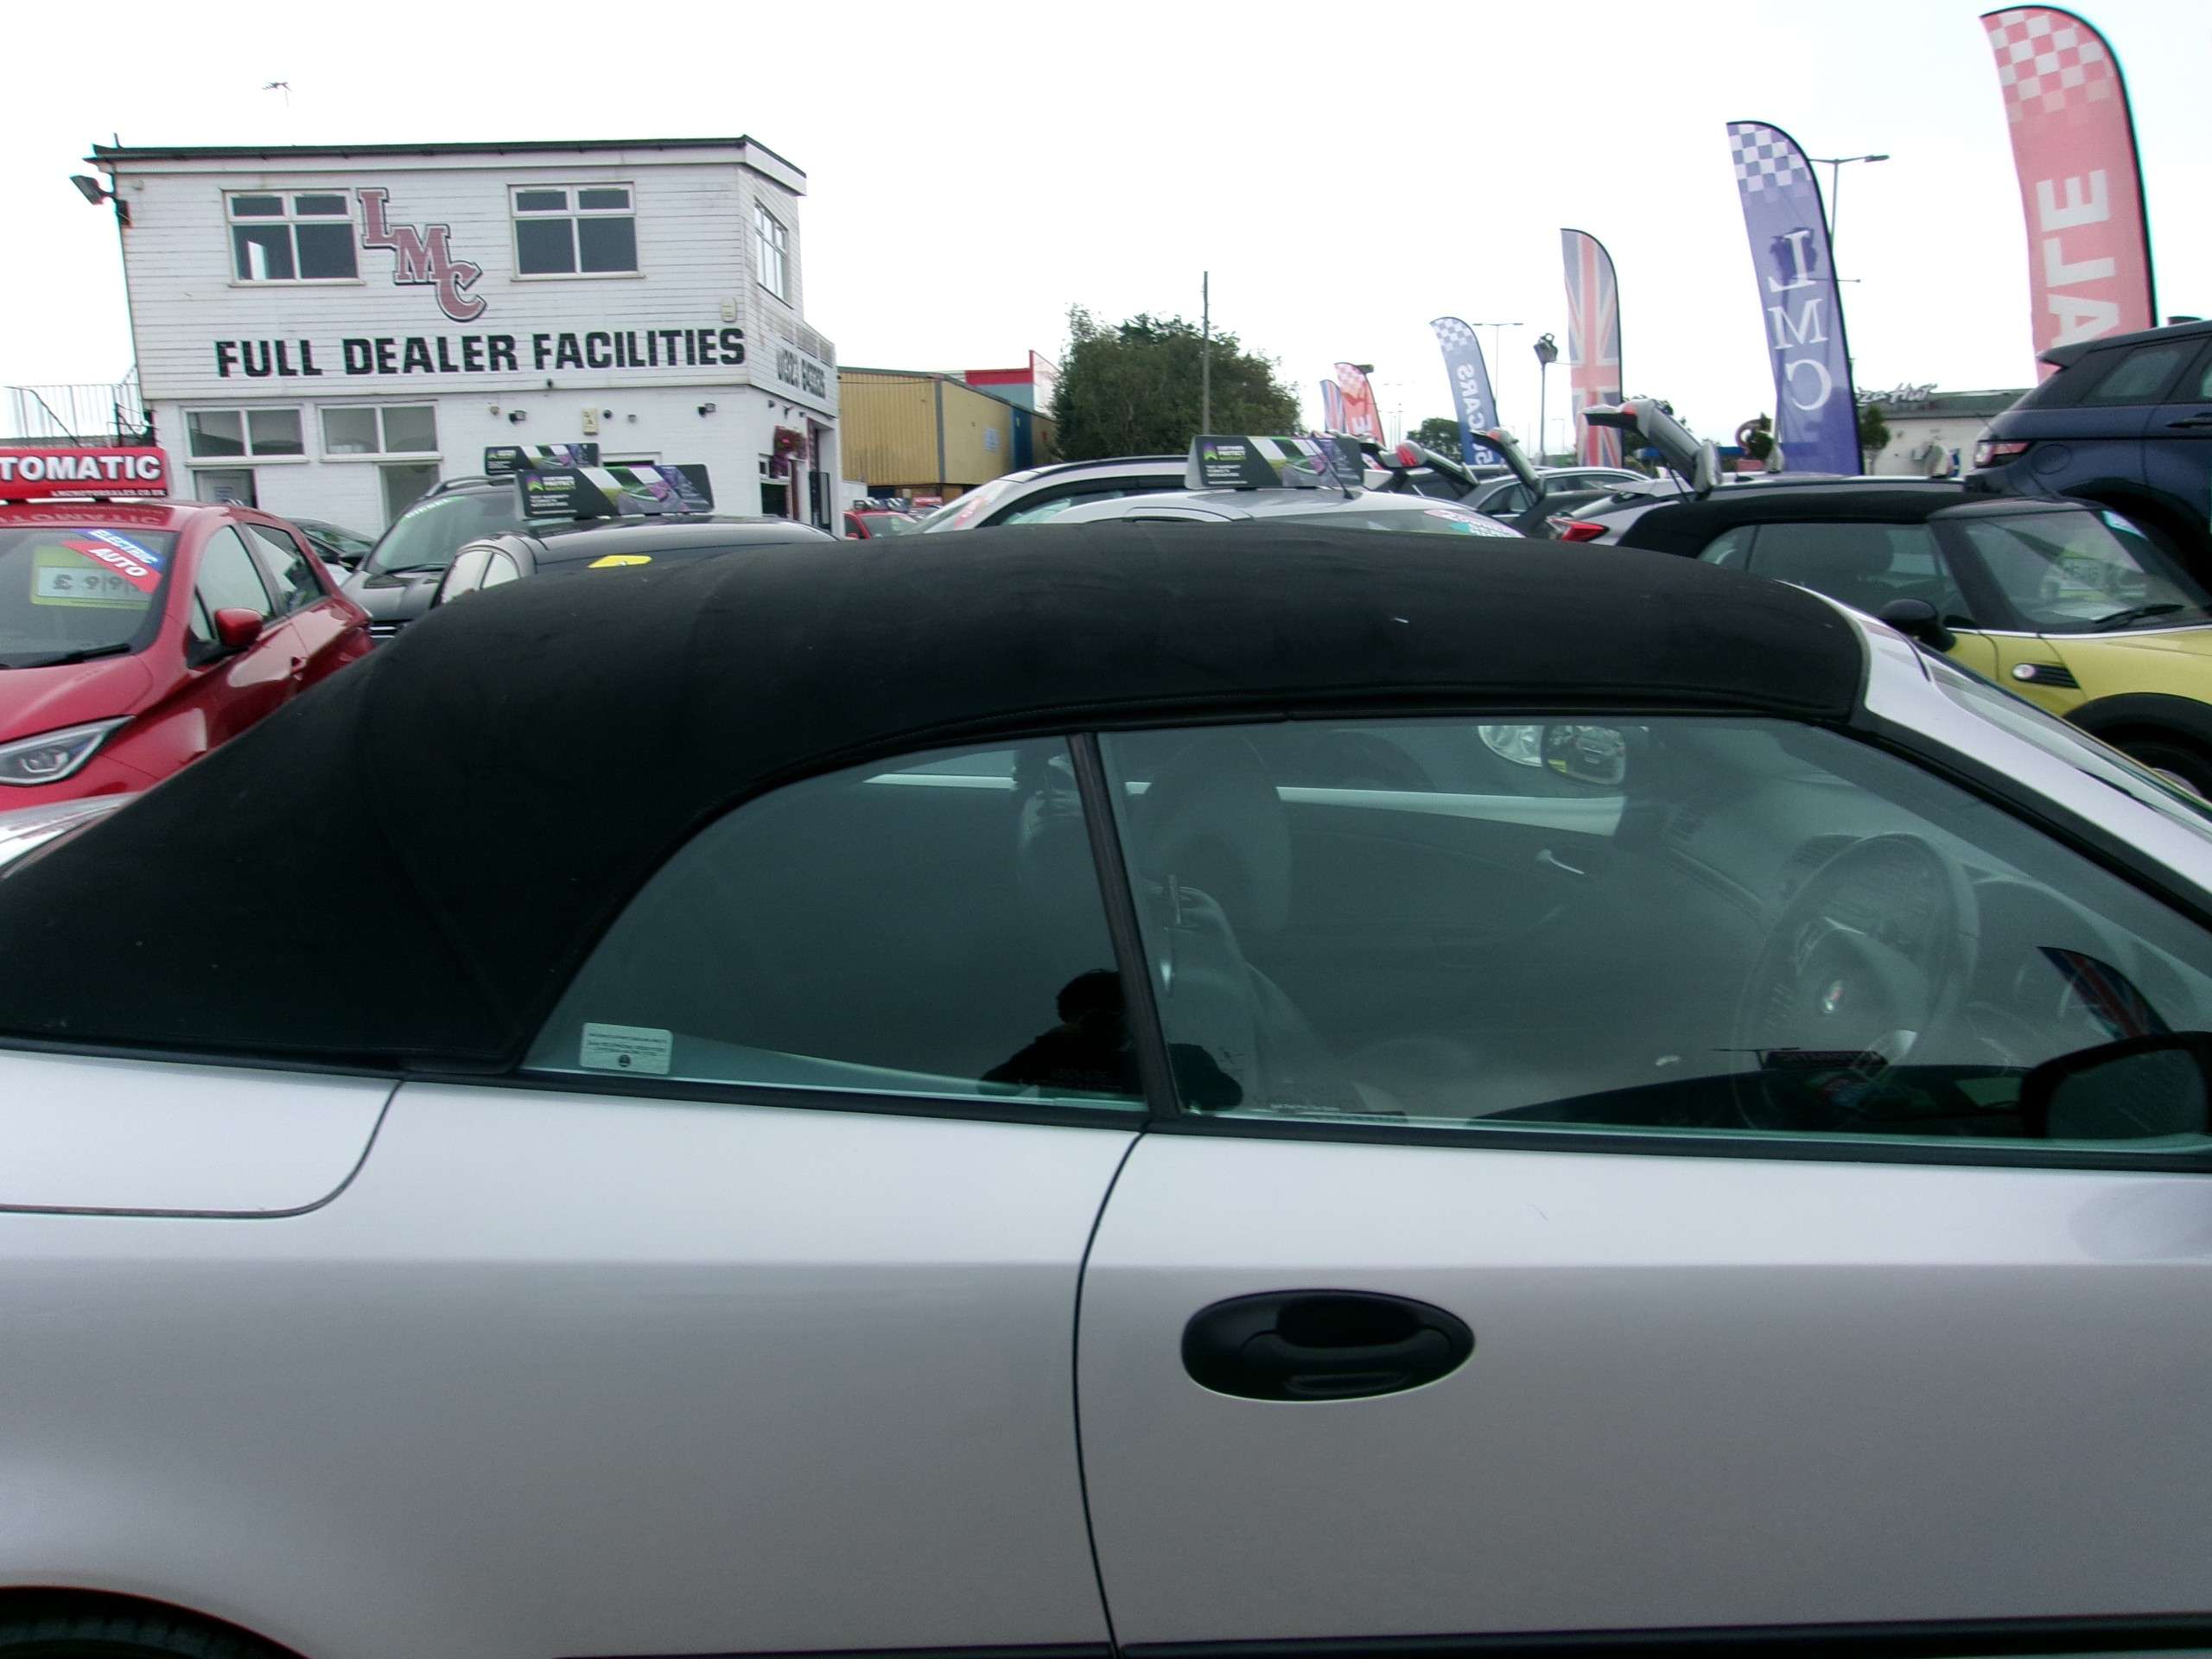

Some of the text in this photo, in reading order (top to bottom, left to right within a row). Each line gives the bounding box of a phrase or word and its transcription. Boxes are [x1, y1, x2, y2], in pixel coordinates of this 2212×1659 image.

[356, 188, 487, 322] LMC
[215, 340, 322, 378] FULL
[342, 334, 518, 375] DEALER
[532, 327, 745, 370] FACILITIES
[88, 529, 159, 564] ELECTRIC
[88, 548, 149, 576] AUTO
